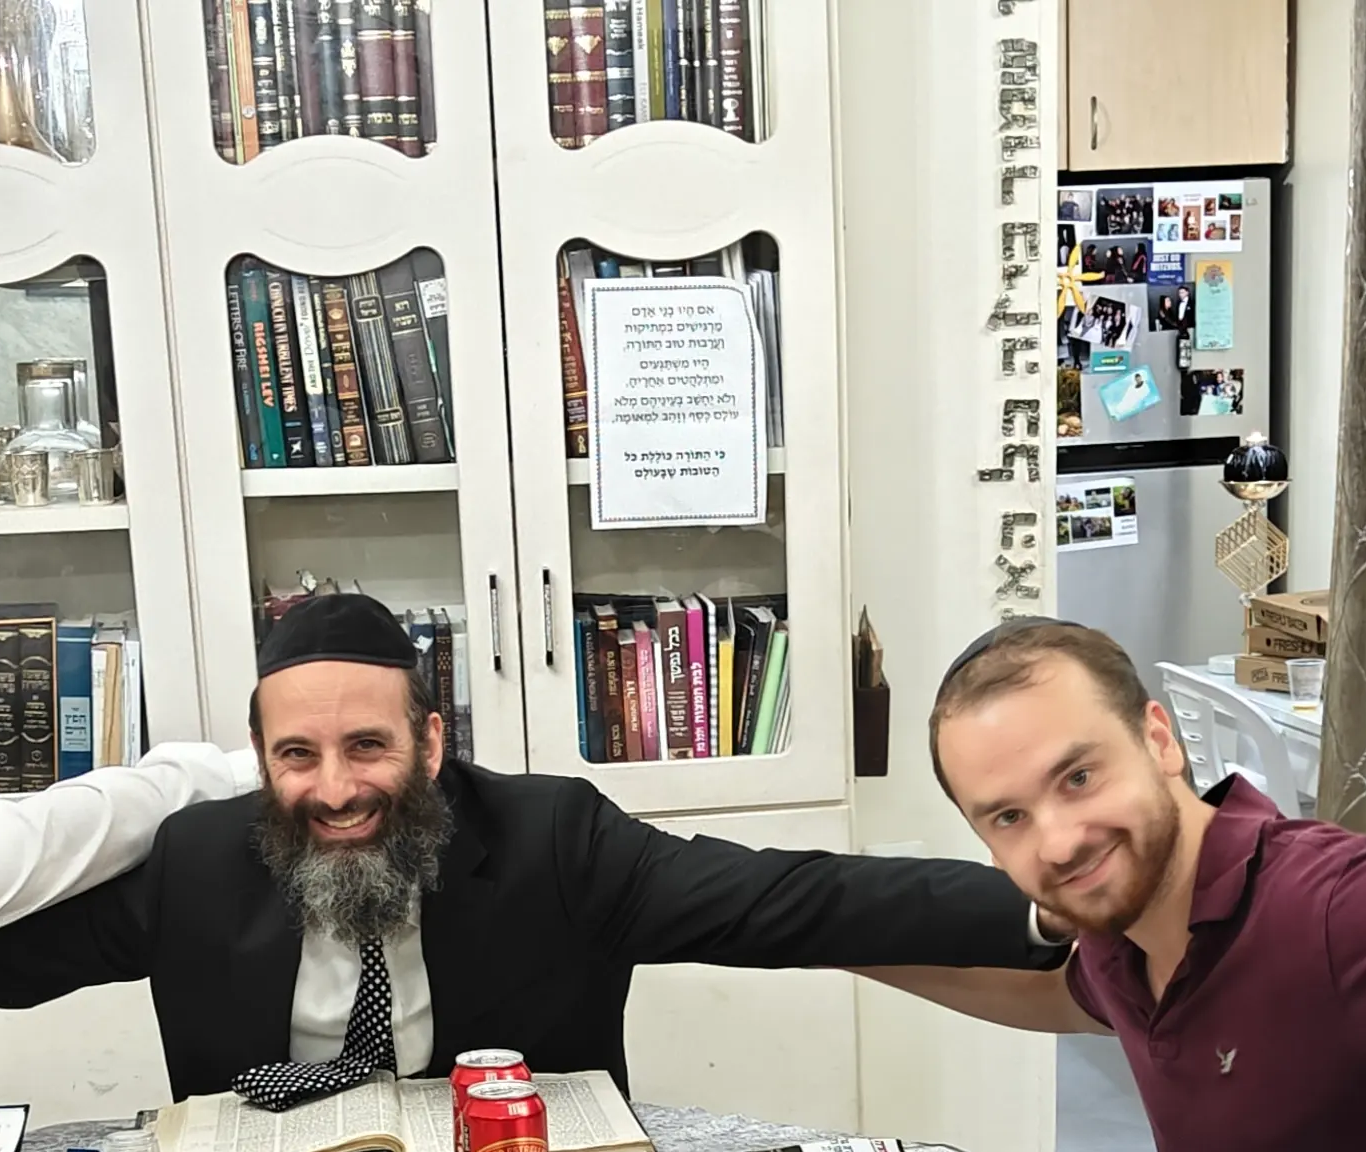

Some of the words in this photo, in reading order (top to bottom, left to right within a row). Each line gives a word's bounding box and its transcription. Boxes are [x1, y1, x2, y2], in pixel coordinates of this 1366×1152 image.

[268, 281, 285, 322] CHINUCH
[631, 305, 656, 317] אדם
[659, 305, 675, 317] בני
[678, 305, 695, 317] היו
[697, 305, 715, 317] אם
[676, 322, 723, 334] מרגישים
[253, 322, 271, 379] RIGSHEI
[668, 338, 687, 350] טוב
[276, 334, 295, 385] TURBULENT
[692, 358, 710, 370] היו
[261, 381, 275, 408] LEV
[282, 386, 298, 414] TIMES
[716, 394, 736, 407] ולא
[614, 395, 638, 408] מלא
[689, 410, 712, 423] כסף
[714, 409, 740, 422] עולם
[977, 398, 1041, 483] כל
[624, 450, 638, 462] כל
[641, 450, 673, 463] כוללת
[676, 450, 712, 463] התורה
[715, 450, 726, 461] כי
[634, 466, 677, 479] שבעולם
[680, 466, 720, 478] הטובות
[663, 626, 681, 651] בכל
[669, 652, 685, 684] נפשך
